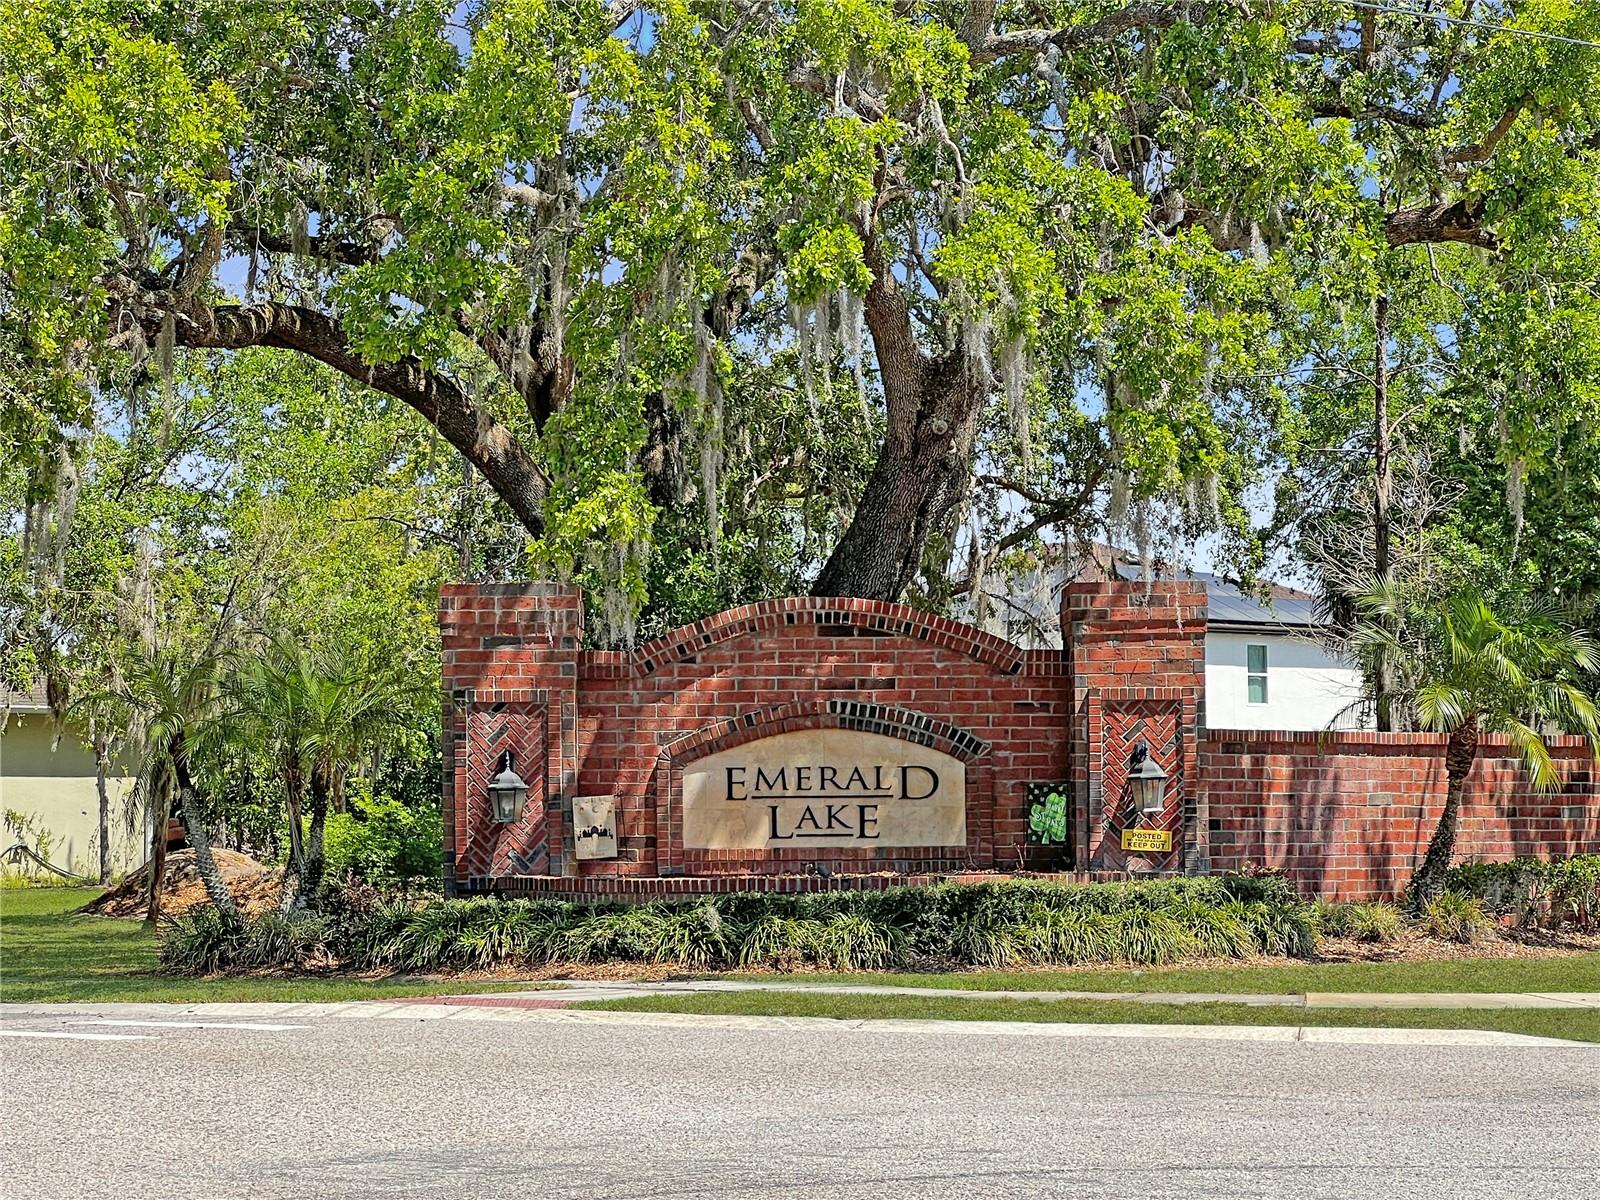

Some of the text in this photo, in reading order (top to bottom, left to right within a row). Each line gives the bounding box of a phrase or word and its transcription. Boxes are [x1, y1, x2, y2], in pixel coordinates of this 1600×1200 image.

[725, 765, 940, 801] EMERALD
[768, 804, 881, 840] LAKE
[1131, 832, 1162, 840] POSTED
